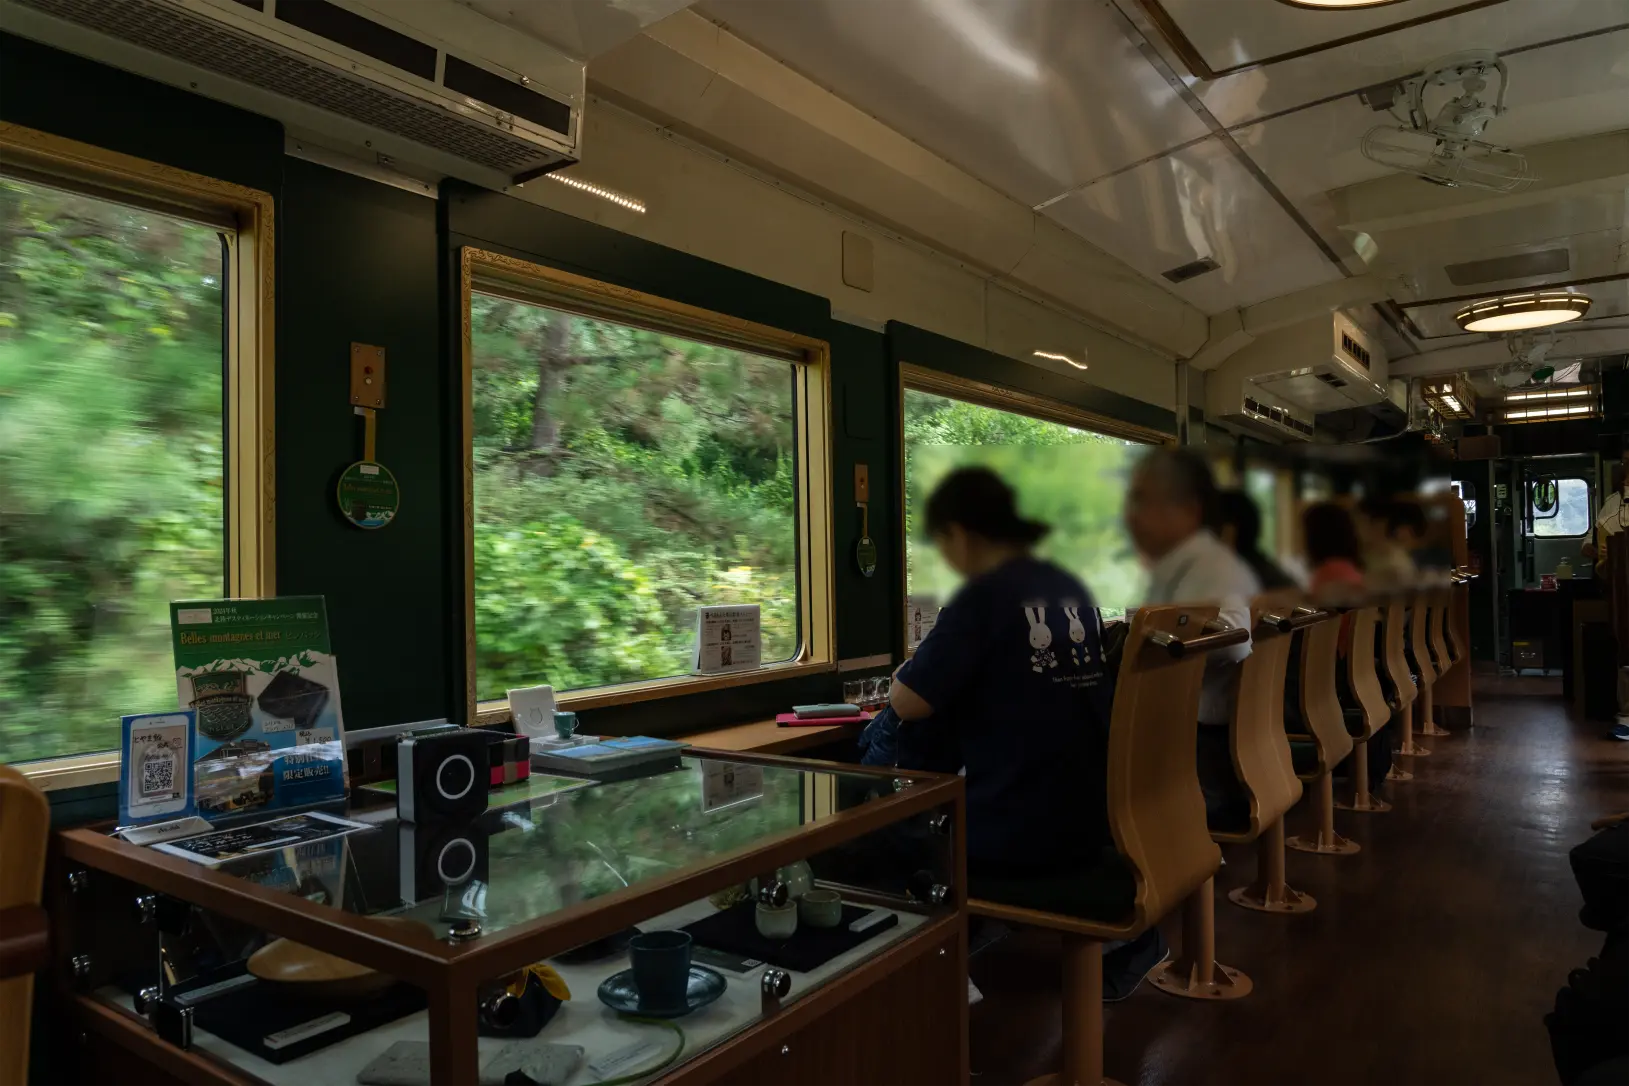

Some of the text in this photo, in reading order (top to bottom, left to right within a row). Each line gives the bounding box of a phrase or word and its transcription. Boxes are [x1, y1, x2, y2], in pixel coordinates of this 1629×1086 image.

[180, 629, 281, 644] Belles montagnes et mer
